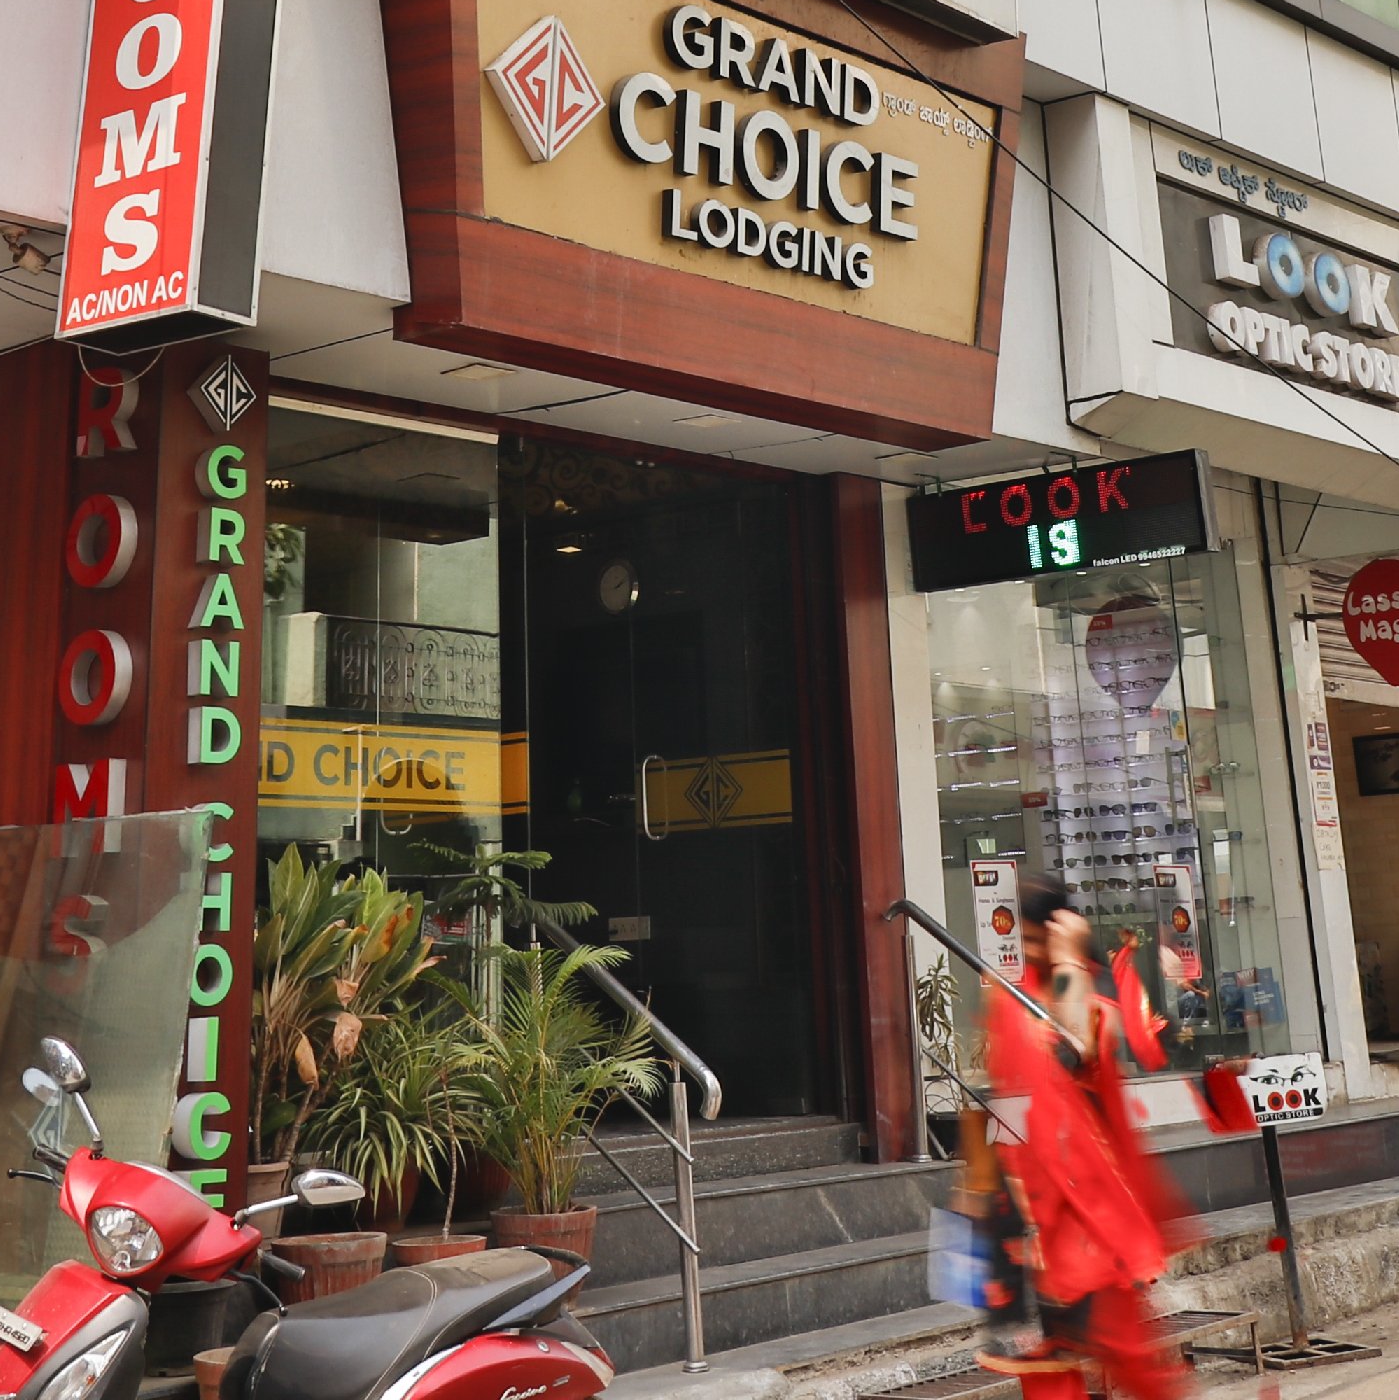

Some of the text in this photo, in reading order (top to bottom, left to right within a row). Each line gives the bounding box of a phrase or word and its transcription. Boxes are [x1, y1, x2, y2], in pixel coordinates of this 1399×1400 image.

[664, 5, 879, 126] GRAND
[610, 72, 918, 241] CHOICE
[663, 188, 874, 290] LODGING
[1208, 213, 1399, 338] LOOK
[66, 271, 184, 325] AC/NON AC
[1207, 300, 1314, 373] OPTIC
[961, 466, 1131, 533] LOOK
[1121, 553, 1137, 564] LED
[190, 444, 248, 765] GRAND
[313, 742, 466, 791] CHOICE
[174, 801, 235, 1209] CHOICE
[1252, 1088, 1321, 1113] LOOK
[1257, 1109, 1314, 1122] OPTIC STORE
